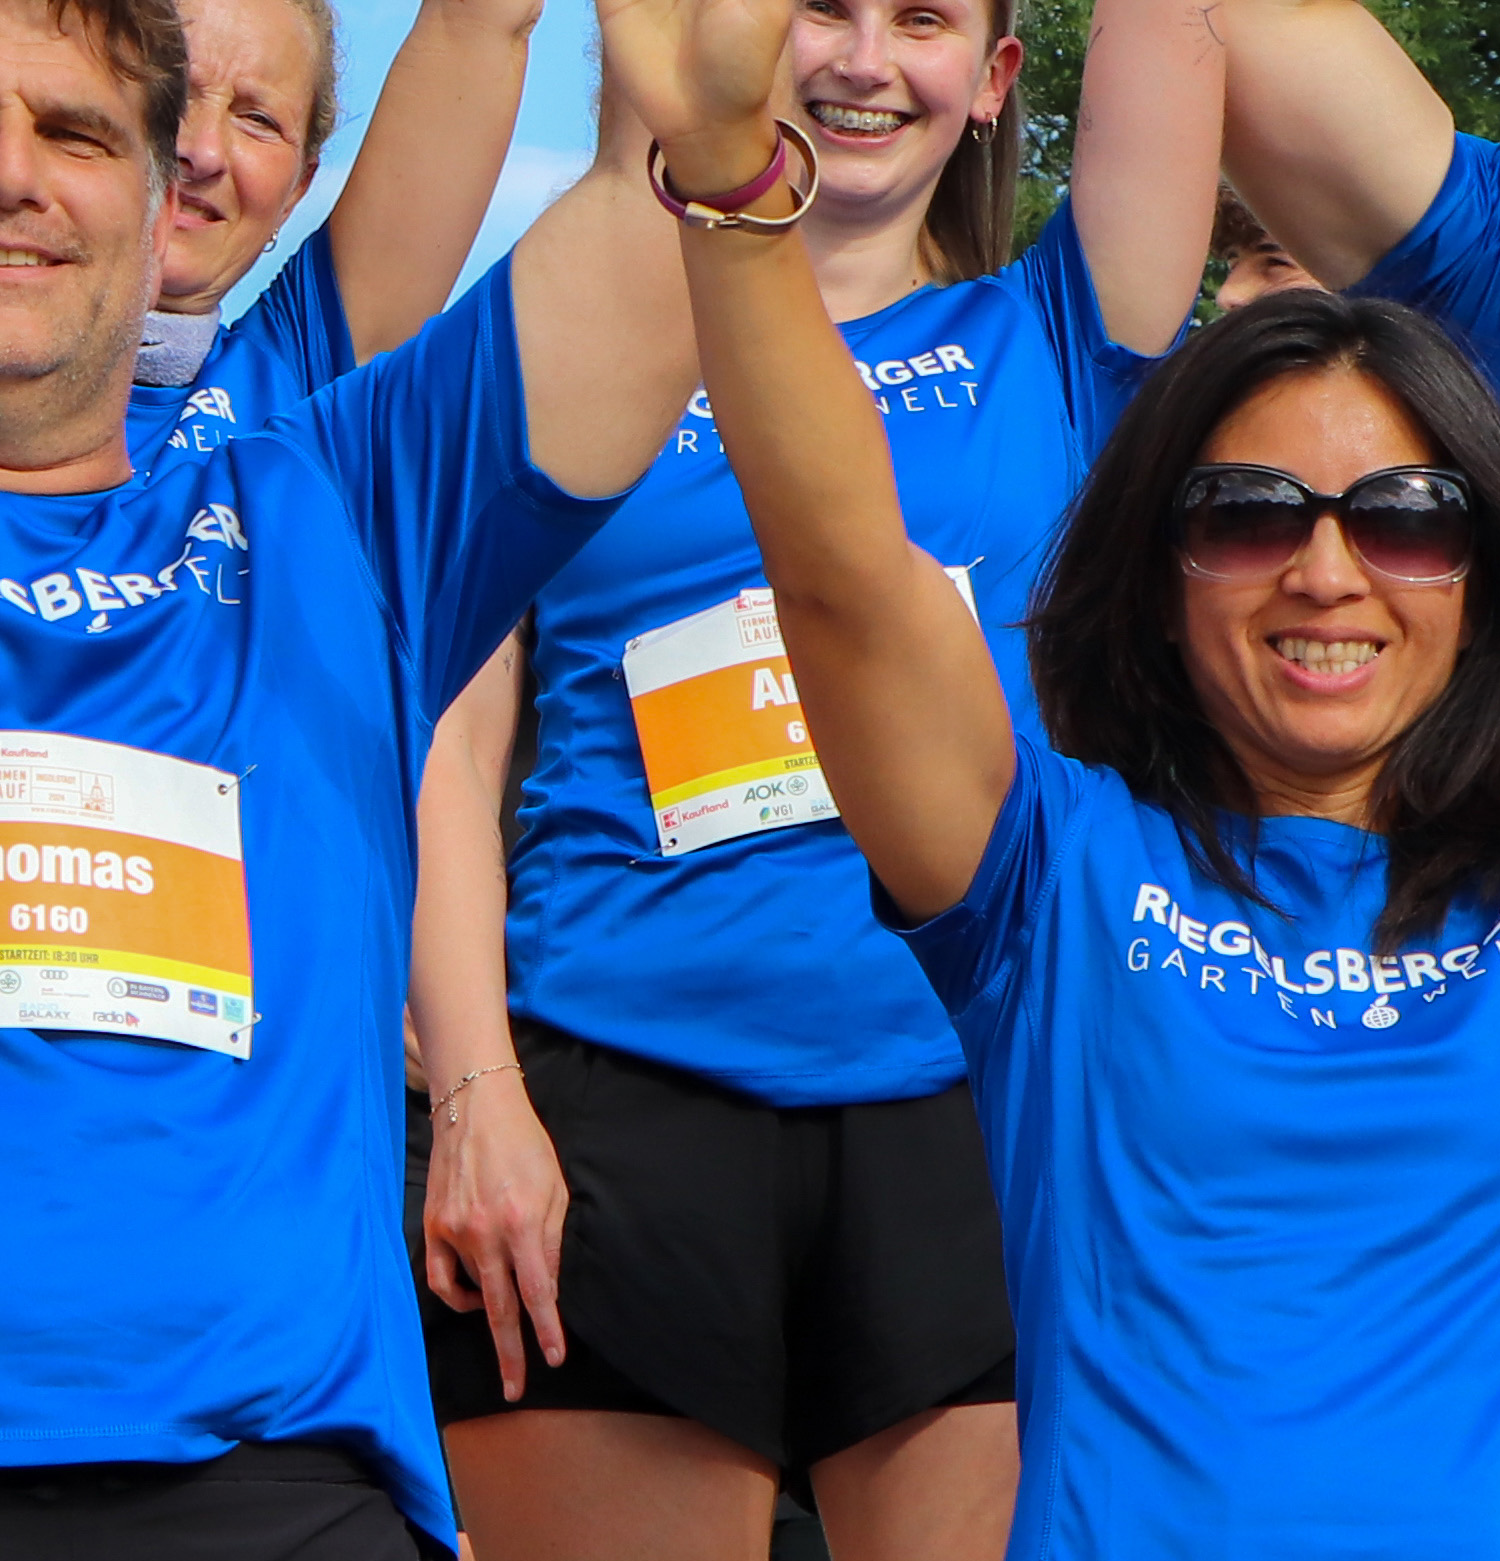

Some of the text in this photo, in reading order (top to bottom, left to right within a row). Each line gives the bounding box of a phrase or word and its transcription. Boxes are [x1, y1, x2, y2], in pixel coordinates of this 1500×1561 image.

[1, 747, 48, 759] Kaufland
[681, 799, 730, 823] Kaufland
[743, 782, 786, 805] AOK
[772, 803, 793, 817] VGI
[10, 903, 88, 935] 6160
[52, 951, 77, 962] 18:30
[80, 952, 99, 963] UHR
[1127, 938, 1337, 1030] GARTEN
[18, 1010, 71, 1020] GALAXY
